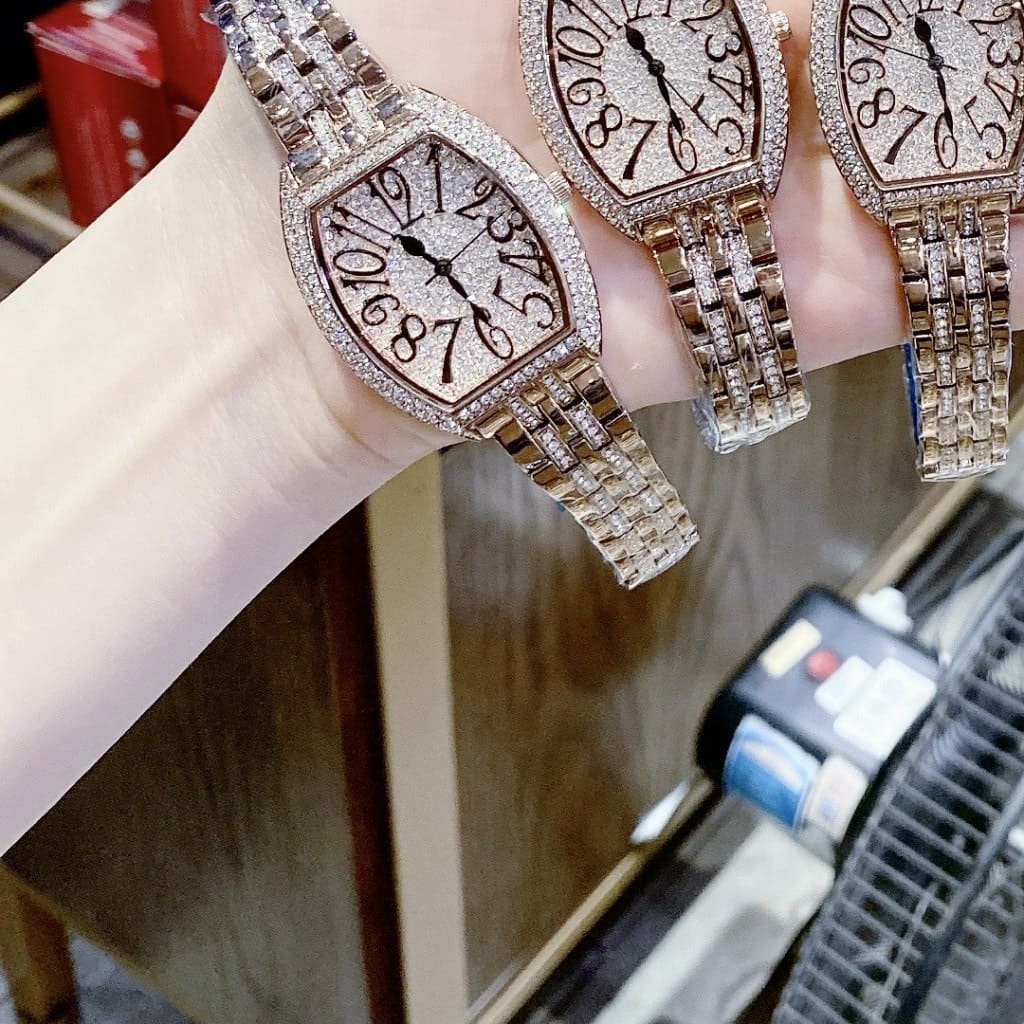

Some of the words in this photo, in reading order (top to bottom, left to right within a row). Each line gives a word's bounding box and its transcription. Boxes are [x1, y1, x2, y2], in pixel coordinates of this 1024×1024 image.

[847, 4, 892, 54] 10
[969, 3, 1015, 36] 2
[556, 26, 604, 71] 10
[705, 32, 742, 62] 3
[987, 39, 1022, 68] 3
[567, 78, 606, 105] 9
[708, 66, 752, 113] 4
[848, 57, 885, 85] 9
[857, 87, 895, 128] 8
[984, 72, 1023, 120] 4
[585, 104, 623, 148] 8
[668, 117, 698, 173] 6
[692, 93, 744, 154] 5
[884, 105, 926, 165] 7
[934, 112, 958, 169] 6
[964, 96, 1006, 160] 5
[623, 118, 657, 179] 7
[367, 167, 424, 230] 12
[426, 143, 445, 213] 1
[455, 177, 498, 219] 2
[325, 202, 396, 253] 11
[487, 207, 525, 243] 3
[333, 249, 390, 290] 10
[498, 239, 550, 285] 4
[361, 294, 400, 325] 9
[493, 278, 555, 329] 5
[391, 315, 426, 362] 8
[432, 316, 467, 383] 7
[472, 304, 513, 359] 6
